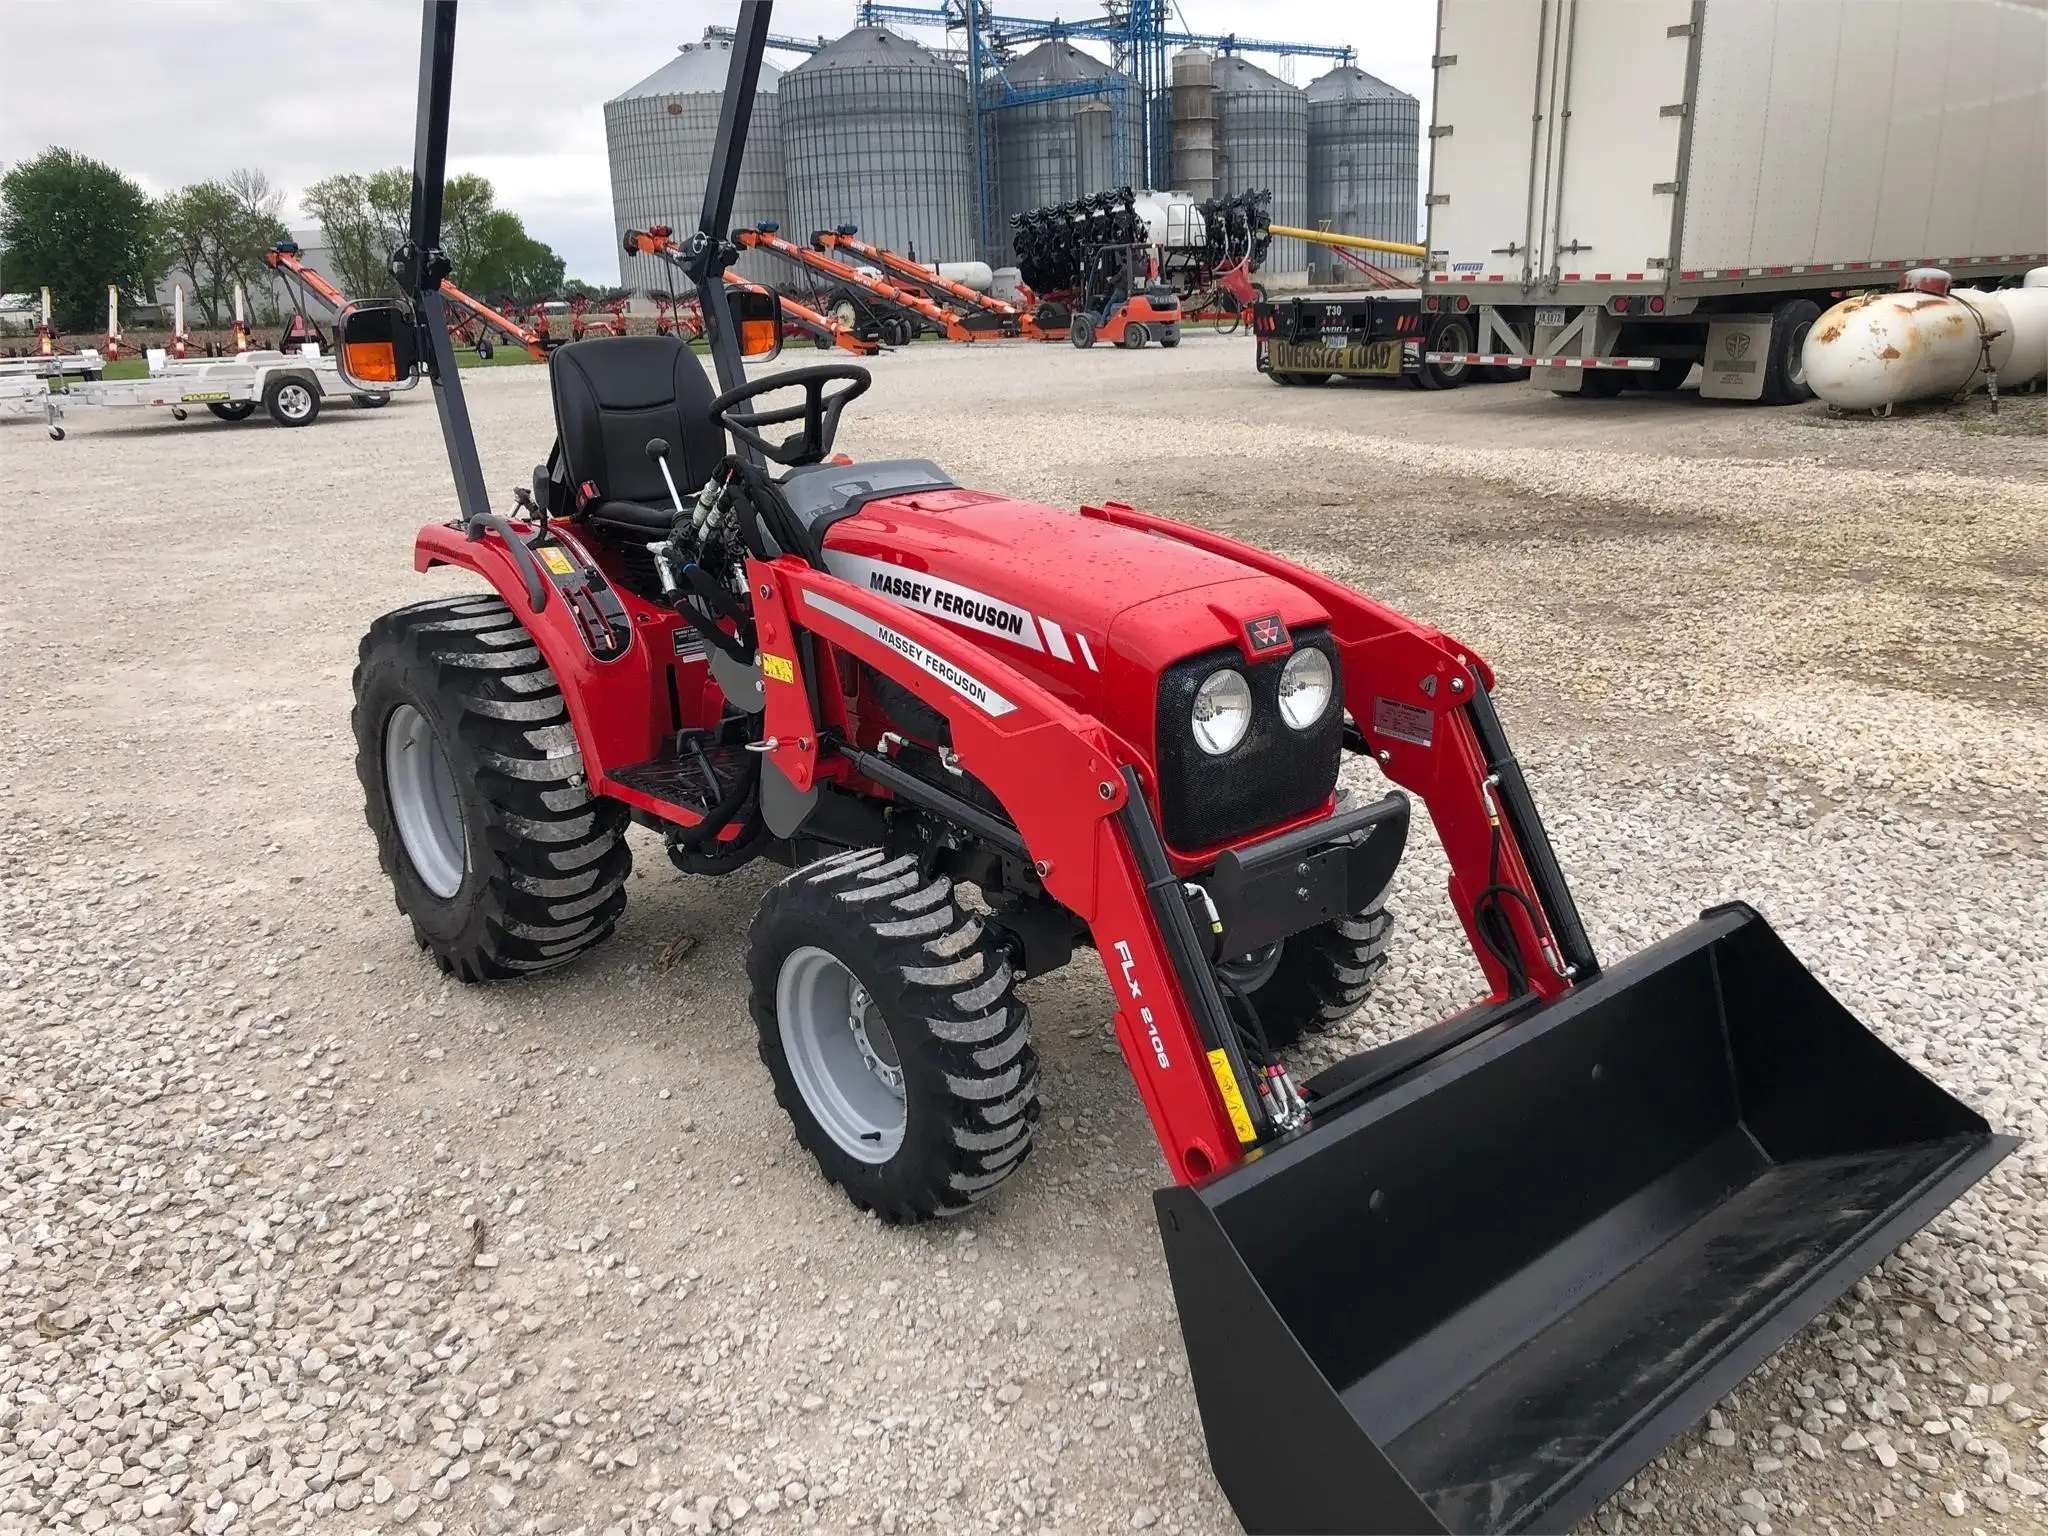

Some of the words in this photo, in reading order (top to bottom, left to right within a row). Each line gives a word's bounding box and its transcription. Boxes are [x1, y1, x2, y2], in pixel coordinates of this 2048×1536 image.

[1325, 304, 1342, 316] T30
[1277, 343, 1344, 369] OVERSIZE
[1348, 343, 1392, 369] LOAD
[869, 571, 932, 604] MASSEY
[933, 590, 1024, 636] FERGUSON
[878, 626, 923, 661] MASSEY
[925, 654, 986, 703] FERGUSON
[1113, 940, 1143, 999] FLX
[1140, 1006, 1170, 1069] 2106
